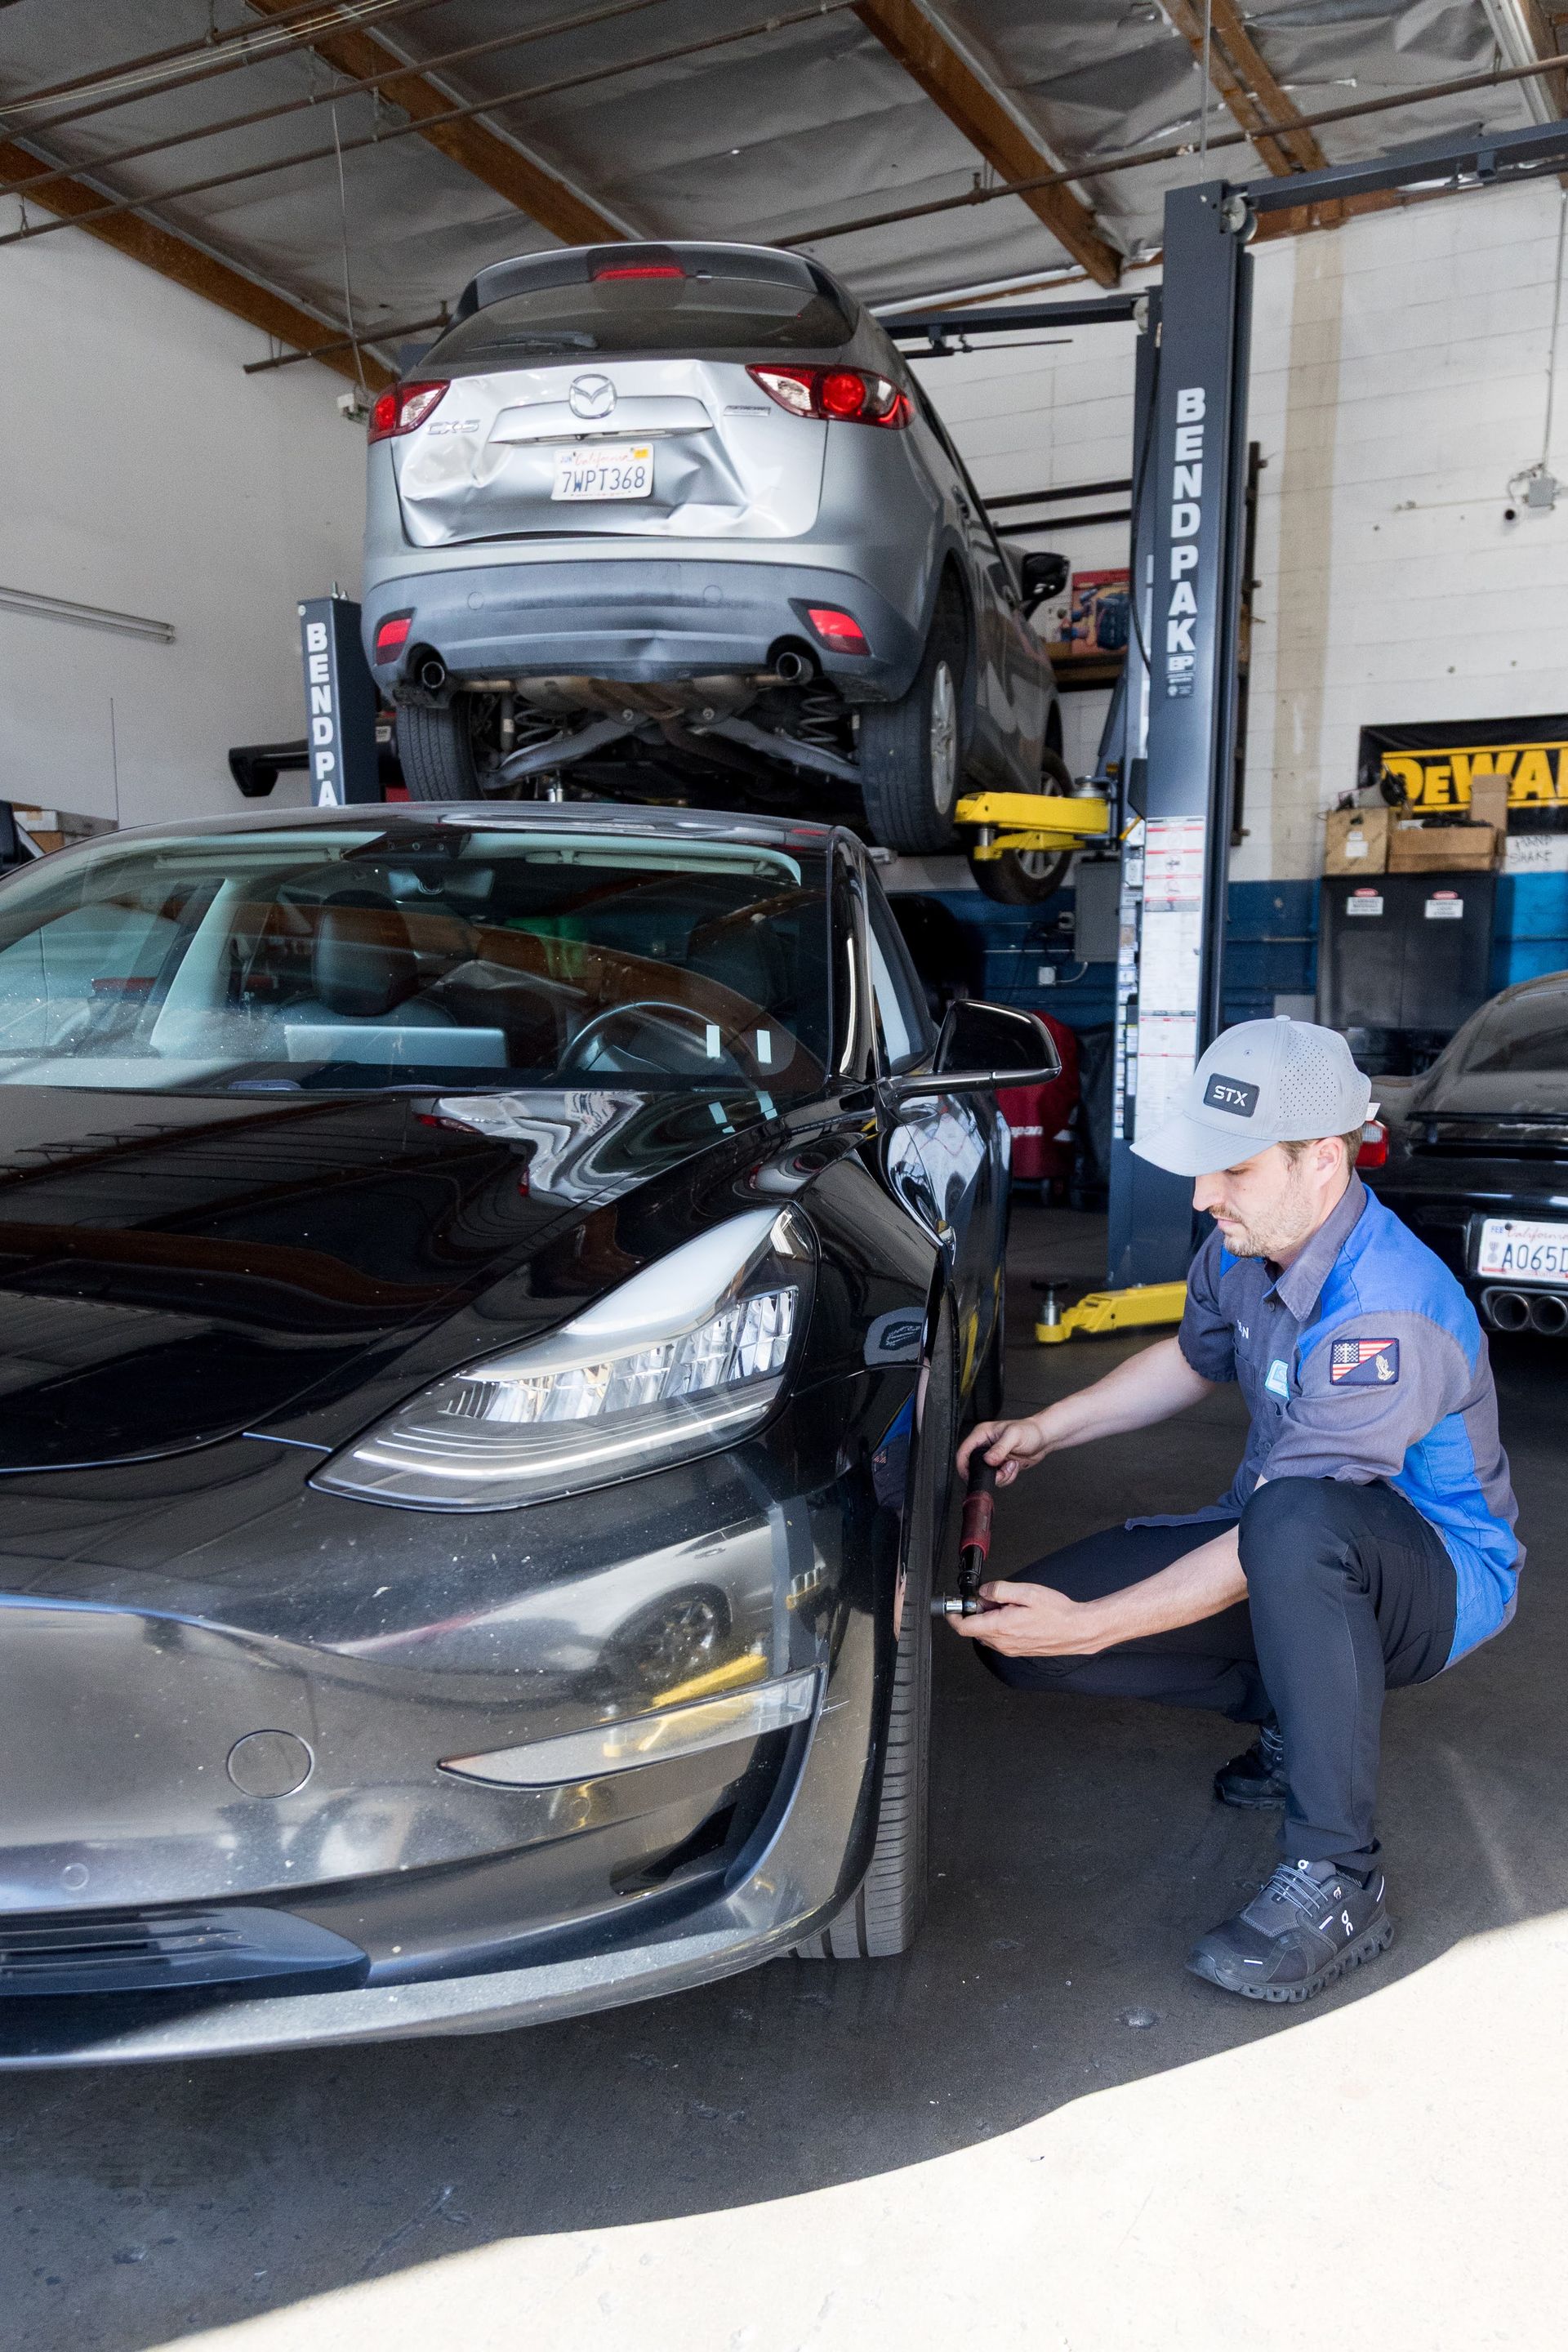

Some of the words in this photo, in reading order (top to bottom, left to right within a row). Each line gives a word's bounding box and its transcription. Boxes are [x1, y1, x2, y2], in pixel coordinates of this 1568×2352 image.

[561, 466, 646, 493] 7WPT368
[306, 621, 338, 808] BENDPA
[1382, 748, 1568, 805] DEWA
[1213, 1085, 1249, 1107] STX
